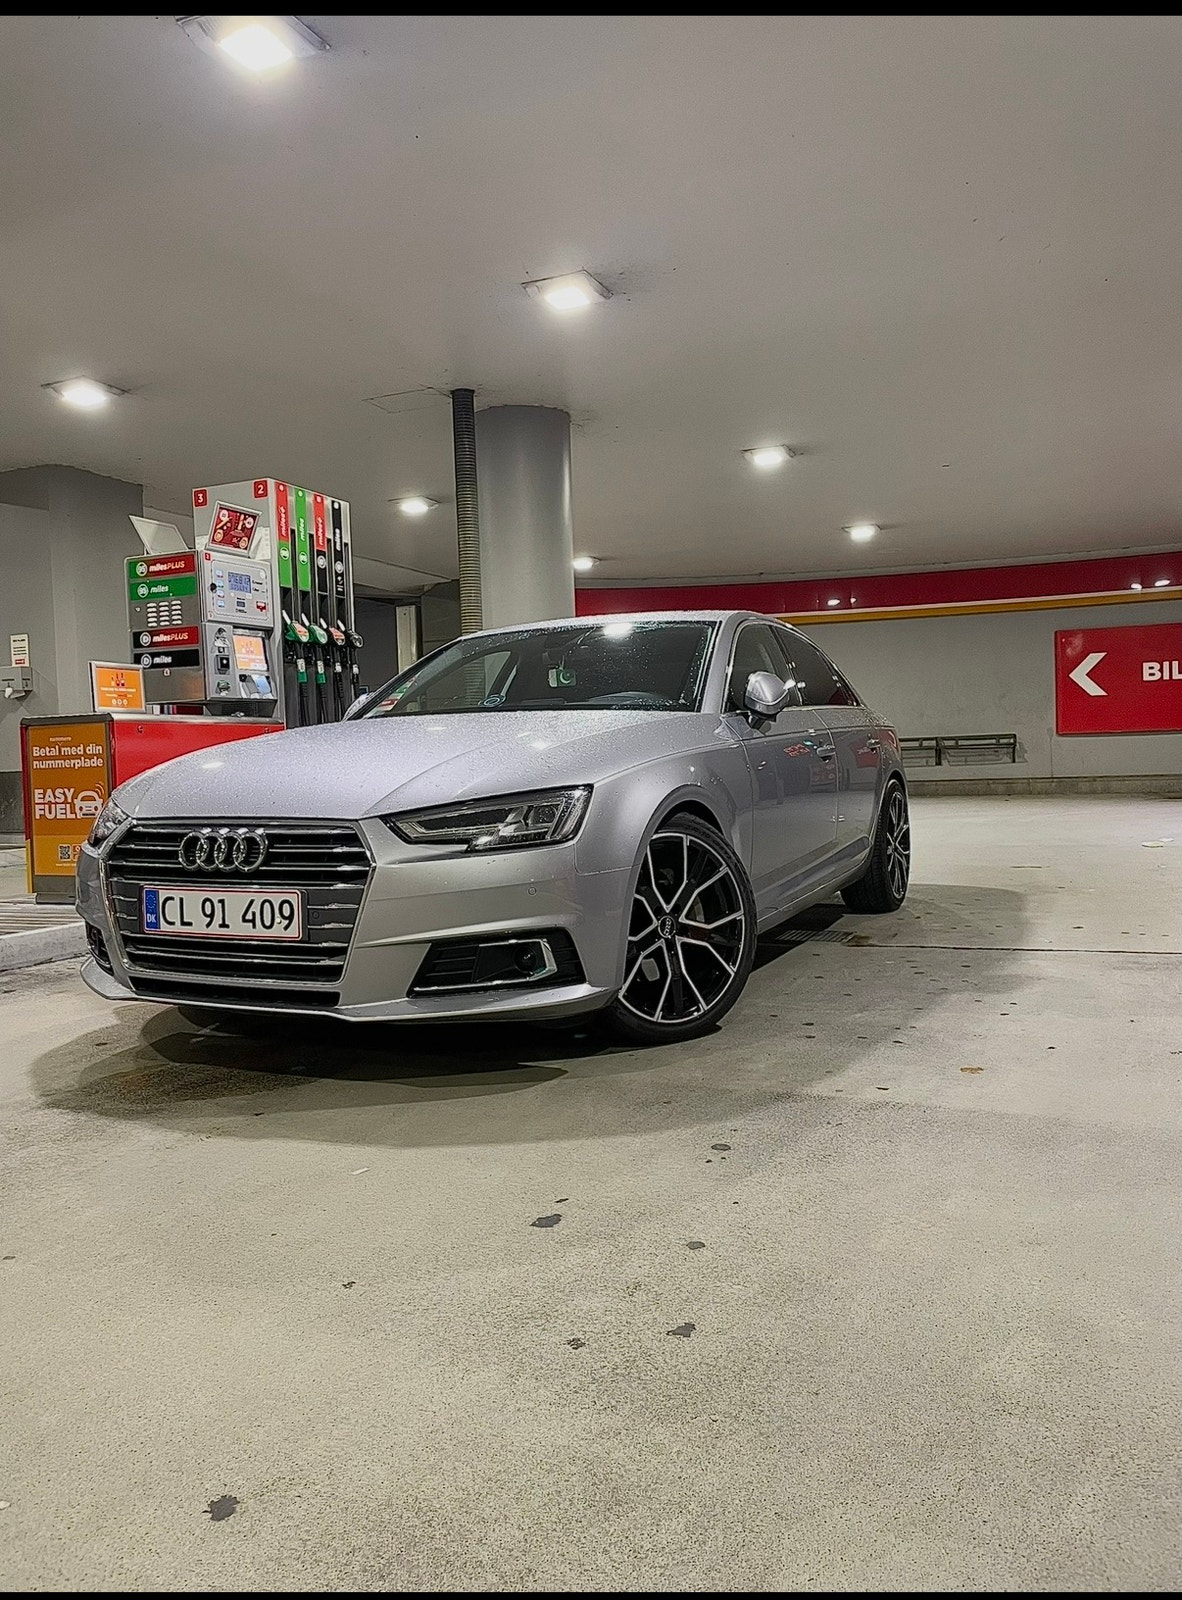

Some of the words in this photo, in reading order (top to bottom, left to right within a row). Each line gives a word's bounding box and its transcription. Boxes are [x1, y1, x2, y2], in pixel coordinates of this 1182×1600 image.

[258, 484, 264, 495] 2
[197, 493, 204, 503] 3
[149, 561, 185, 572] milesPLUS
[150, 585, 169, 594] miles
[152, 632, 189, 642] milesPLUS
[153, 655, 172, 664] miles
[1142, 660, 1182, 681] BIL
[33, 745, 59, 757] Betal
[61, 744, 84, 756] med
[85, 743, 102, 755] din
[33, 756, 104, 769] nummerplade
[34, 787, 75, 804] EASY
[35, 803, 76, 819] FUEL
[147, 914, 156, 923] DK
[161, 896, 193, 927] CL
[201, 897, 230, 929] 91
[241, 897, 295, 932] 409
